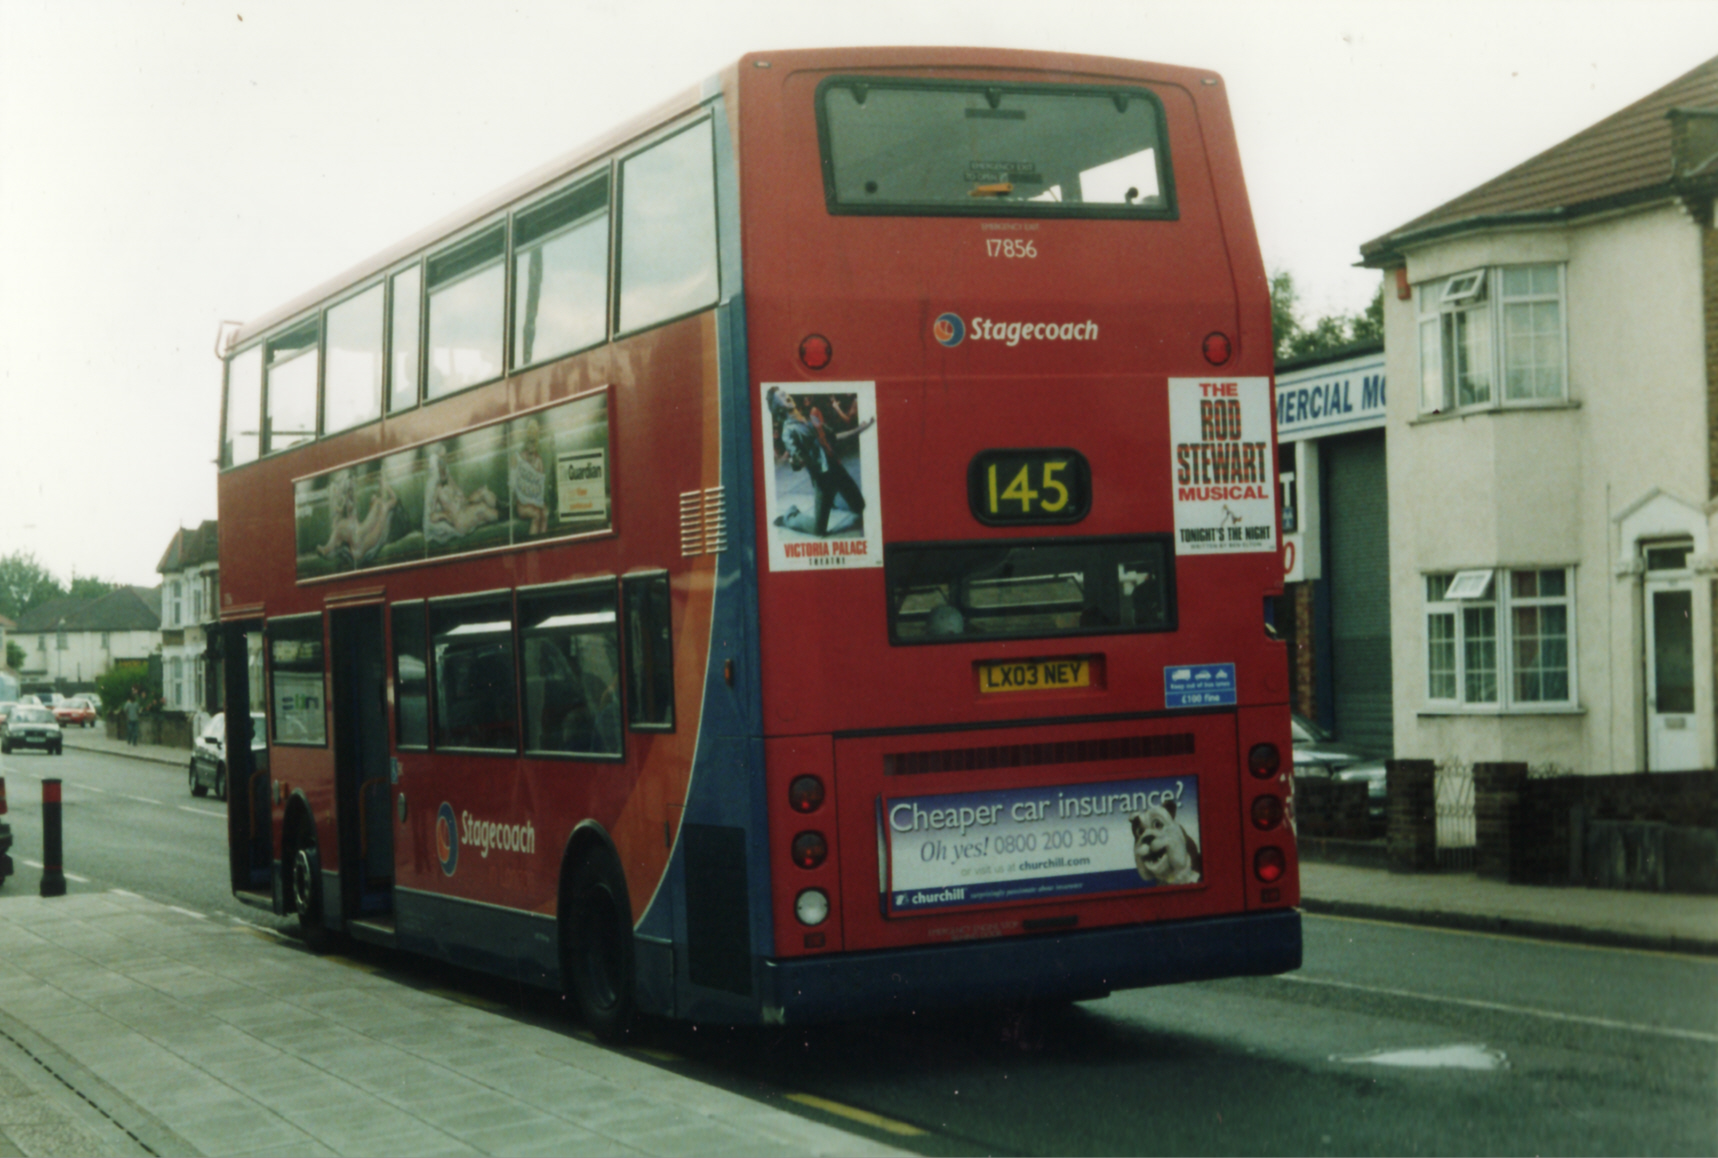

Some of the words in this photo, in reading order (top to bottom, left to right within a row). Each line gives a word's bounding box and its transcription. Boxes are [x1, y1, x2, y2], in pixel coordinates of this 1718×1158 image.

[986, 239, 1037, 258] 17856
[970, 317, 1098, 347] Stagecoach
[1199, 383, 1238, 397] THE
[1200, 399, 1241, 442] ROD
[1177, 442, 1266, 485] STEWART
[988, 462, 1068, 513] 145
[1178, 485, 1269, 501] MUSICAL
[1180, 527, 1225, 542] TONIGHT'S
[1227, 526, 1242, 541] THE
[1245, 525, 1270, 540] NIGHT
[784, 542, 830, 558] VICTORIA
[832, 540, 867, 556] PALACE
[987, 666, 1038, 688] LX03
[1044, 663, 1081, 684] NEY
[889, 802, 1003, 836] Cheaper
[1011, 799, 1050, 822] car
[1058, 780, 1184, 819] insurance?
[461, 810, 535, 859] Stagecoach
[920, 839, 948, 863] Oh
[951, 836, 990, 865] yes!
[994, 835, 1037, 855] 0800
[1042, 831, 1073, 851] 200
[1079, 827, 1109, 848] 300
[960, 868, 971, 877] or
[974, 865, 991, 876] visit
[994, 865, 1004, 874] us
[1007, 863, 1017, 873] at
[1018, 856, 1091, 872] churchill.com
[912, 888, 965, 905] churchill
